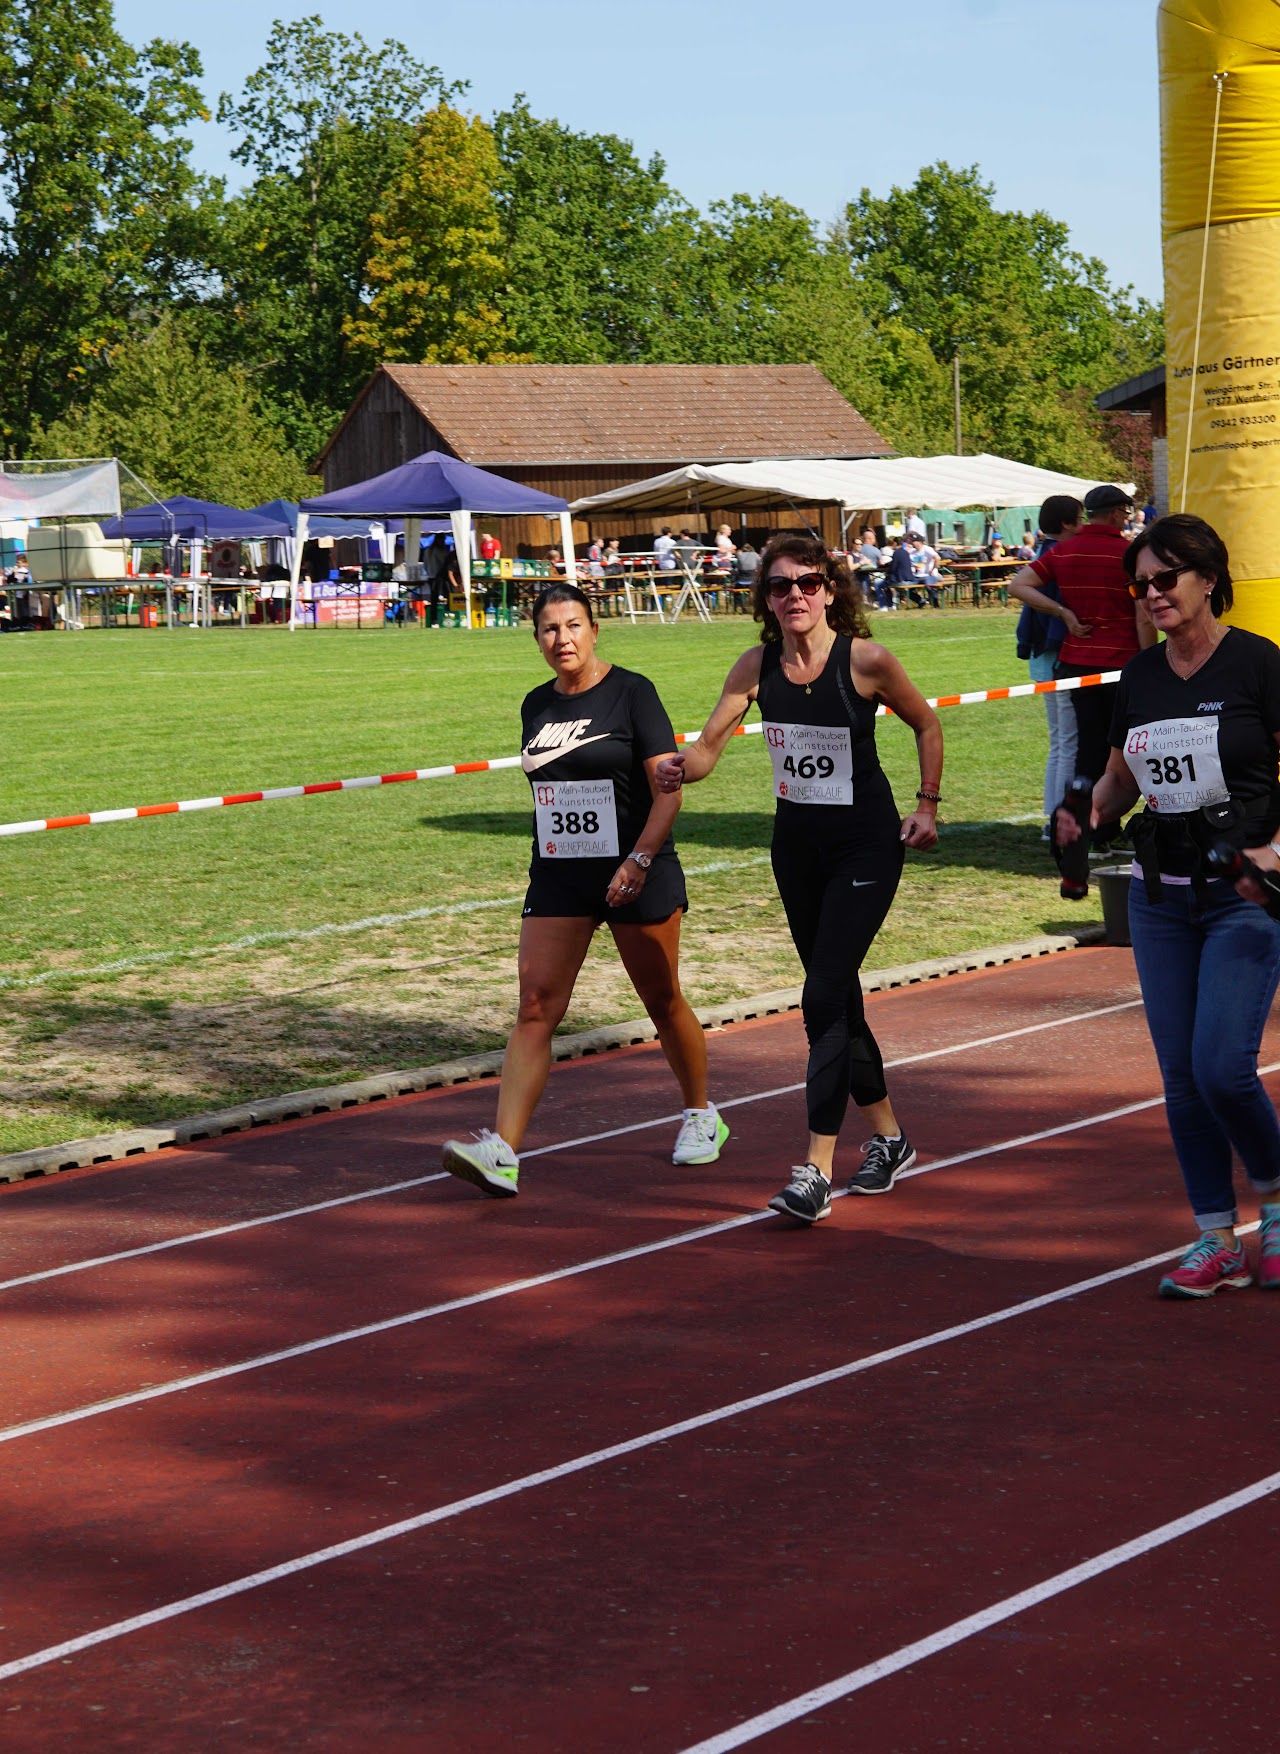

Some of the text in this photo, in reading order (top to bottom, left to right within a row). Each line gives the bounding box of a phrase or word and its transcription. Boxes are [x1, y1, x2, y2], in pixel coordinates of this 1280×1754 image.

[1223, 356, 1280, 370] Gärtner
[1240, 415, 1276, 425] 933300
[528, 718, 593, 749] NIKE
[790, 730, 847, 740] Main-Tauber
[1152, 723, 1219, 737] Main-Tauber
[790, 742, 848, 751] Kunststoff
[1152, 734, 1214, 751] Kunststoff
[783, 755, 835, 779] 469
[1145, 754, 1197, 785] 381
[558, 785, 611, 795] Main-Tauber
[559, 797, 612, 807] Kunststoff
[551, 811, 600, 835] 388
